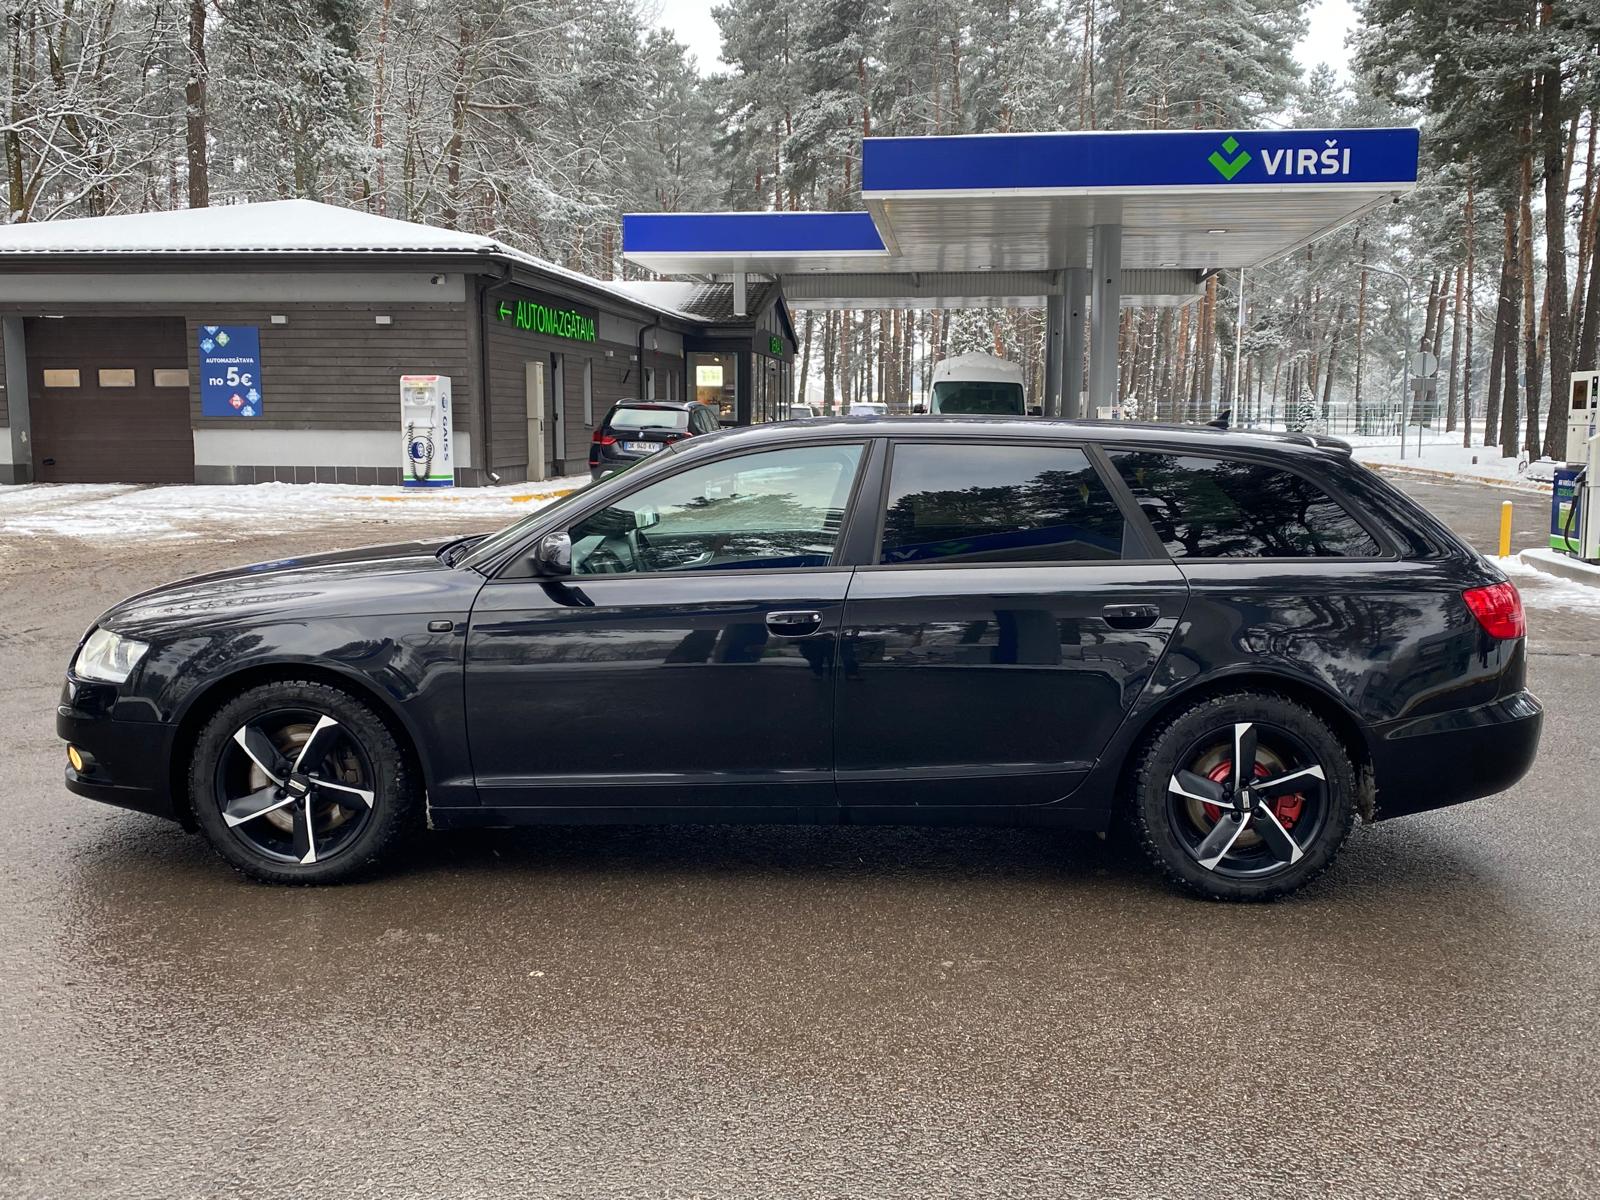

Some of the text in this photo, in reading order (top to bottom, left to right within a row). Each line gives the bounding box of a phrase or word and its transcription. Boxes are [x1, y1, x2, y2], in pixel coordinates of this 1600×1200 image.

[1261, 139, 1350, 175] VIRŠI
[516, 300, 596, 342] AUTOMAZGĀTAVA
[205, 356, 254, 364] AUTOMAZGĀTAVA
[209, 366, 253, 387] no 5€
